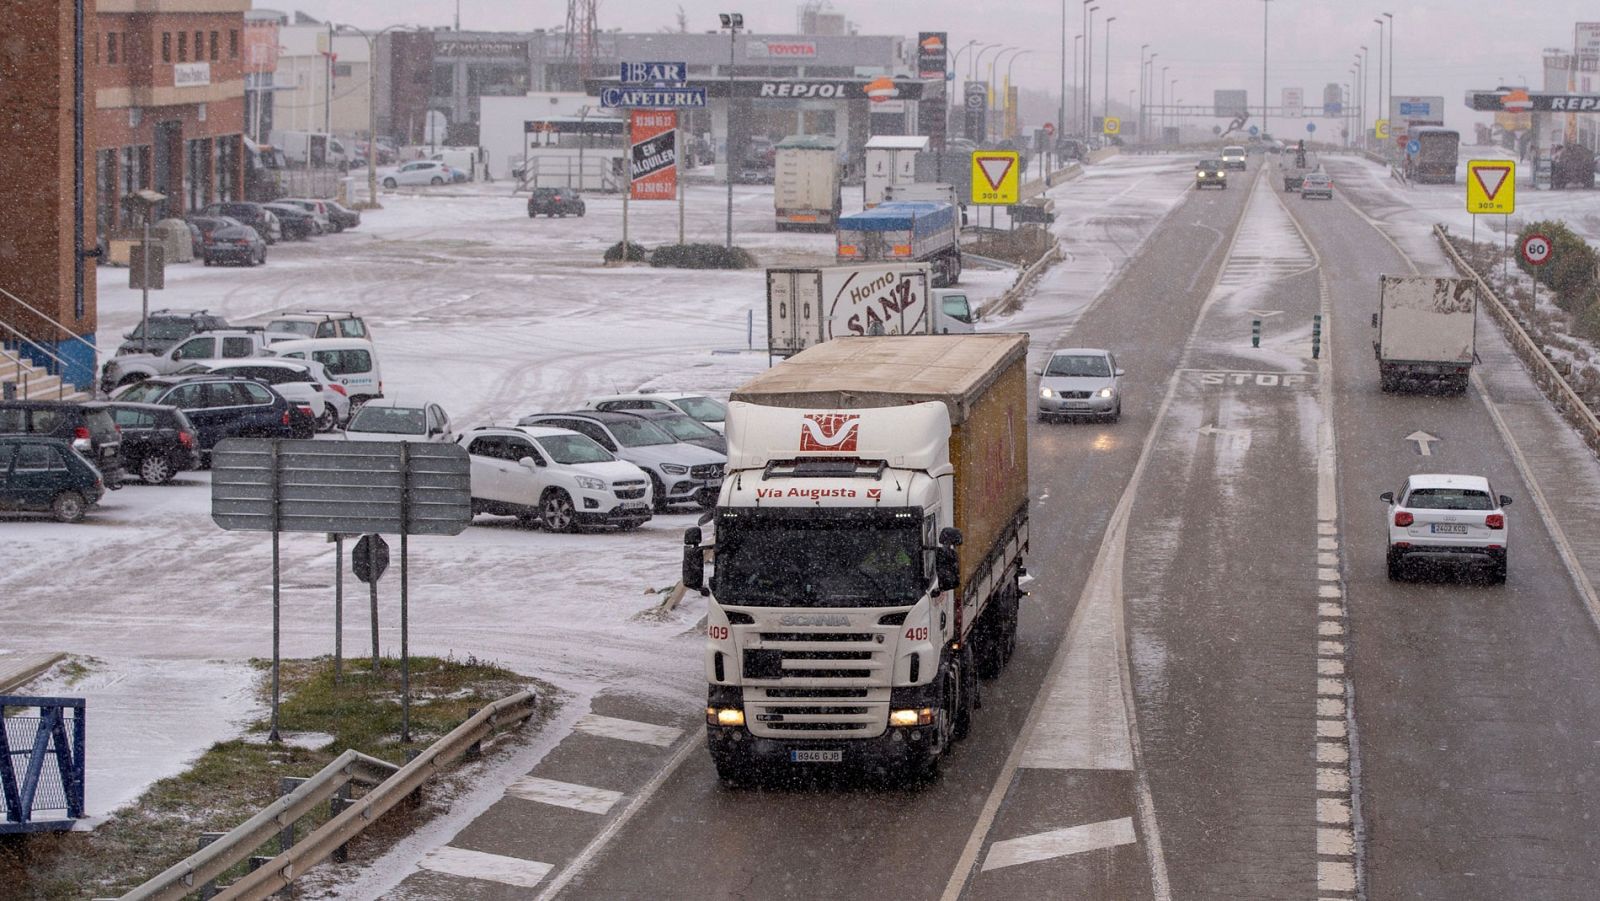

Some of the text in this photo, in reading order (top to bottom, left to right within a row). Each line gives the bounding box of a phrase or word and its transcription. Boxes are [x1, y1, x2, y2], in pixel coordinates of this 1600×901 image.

[768, 44, 814, 55] TOYOTA
[626, 62, 679, 82] BAR
[602, 87, 703, 107] CAFETERIA
[760, 83, 846, 98] REPSOL
[642, 143, 656, 156] EN
[632, 149, 675, 175] ALQUILER
[1528, 244, 1545, 254] 60
[850, 272, 894, 305] Horno
[847, 279, 917, 336] SANZ
[1200, 373, 1307, 387] STOP
[757, 488, 856, 500] Vía Augusta
[780, 615, 850, 627] SCANIA
[709, 626, 728, 640] 409
[905, 627, 928, 641] 409
